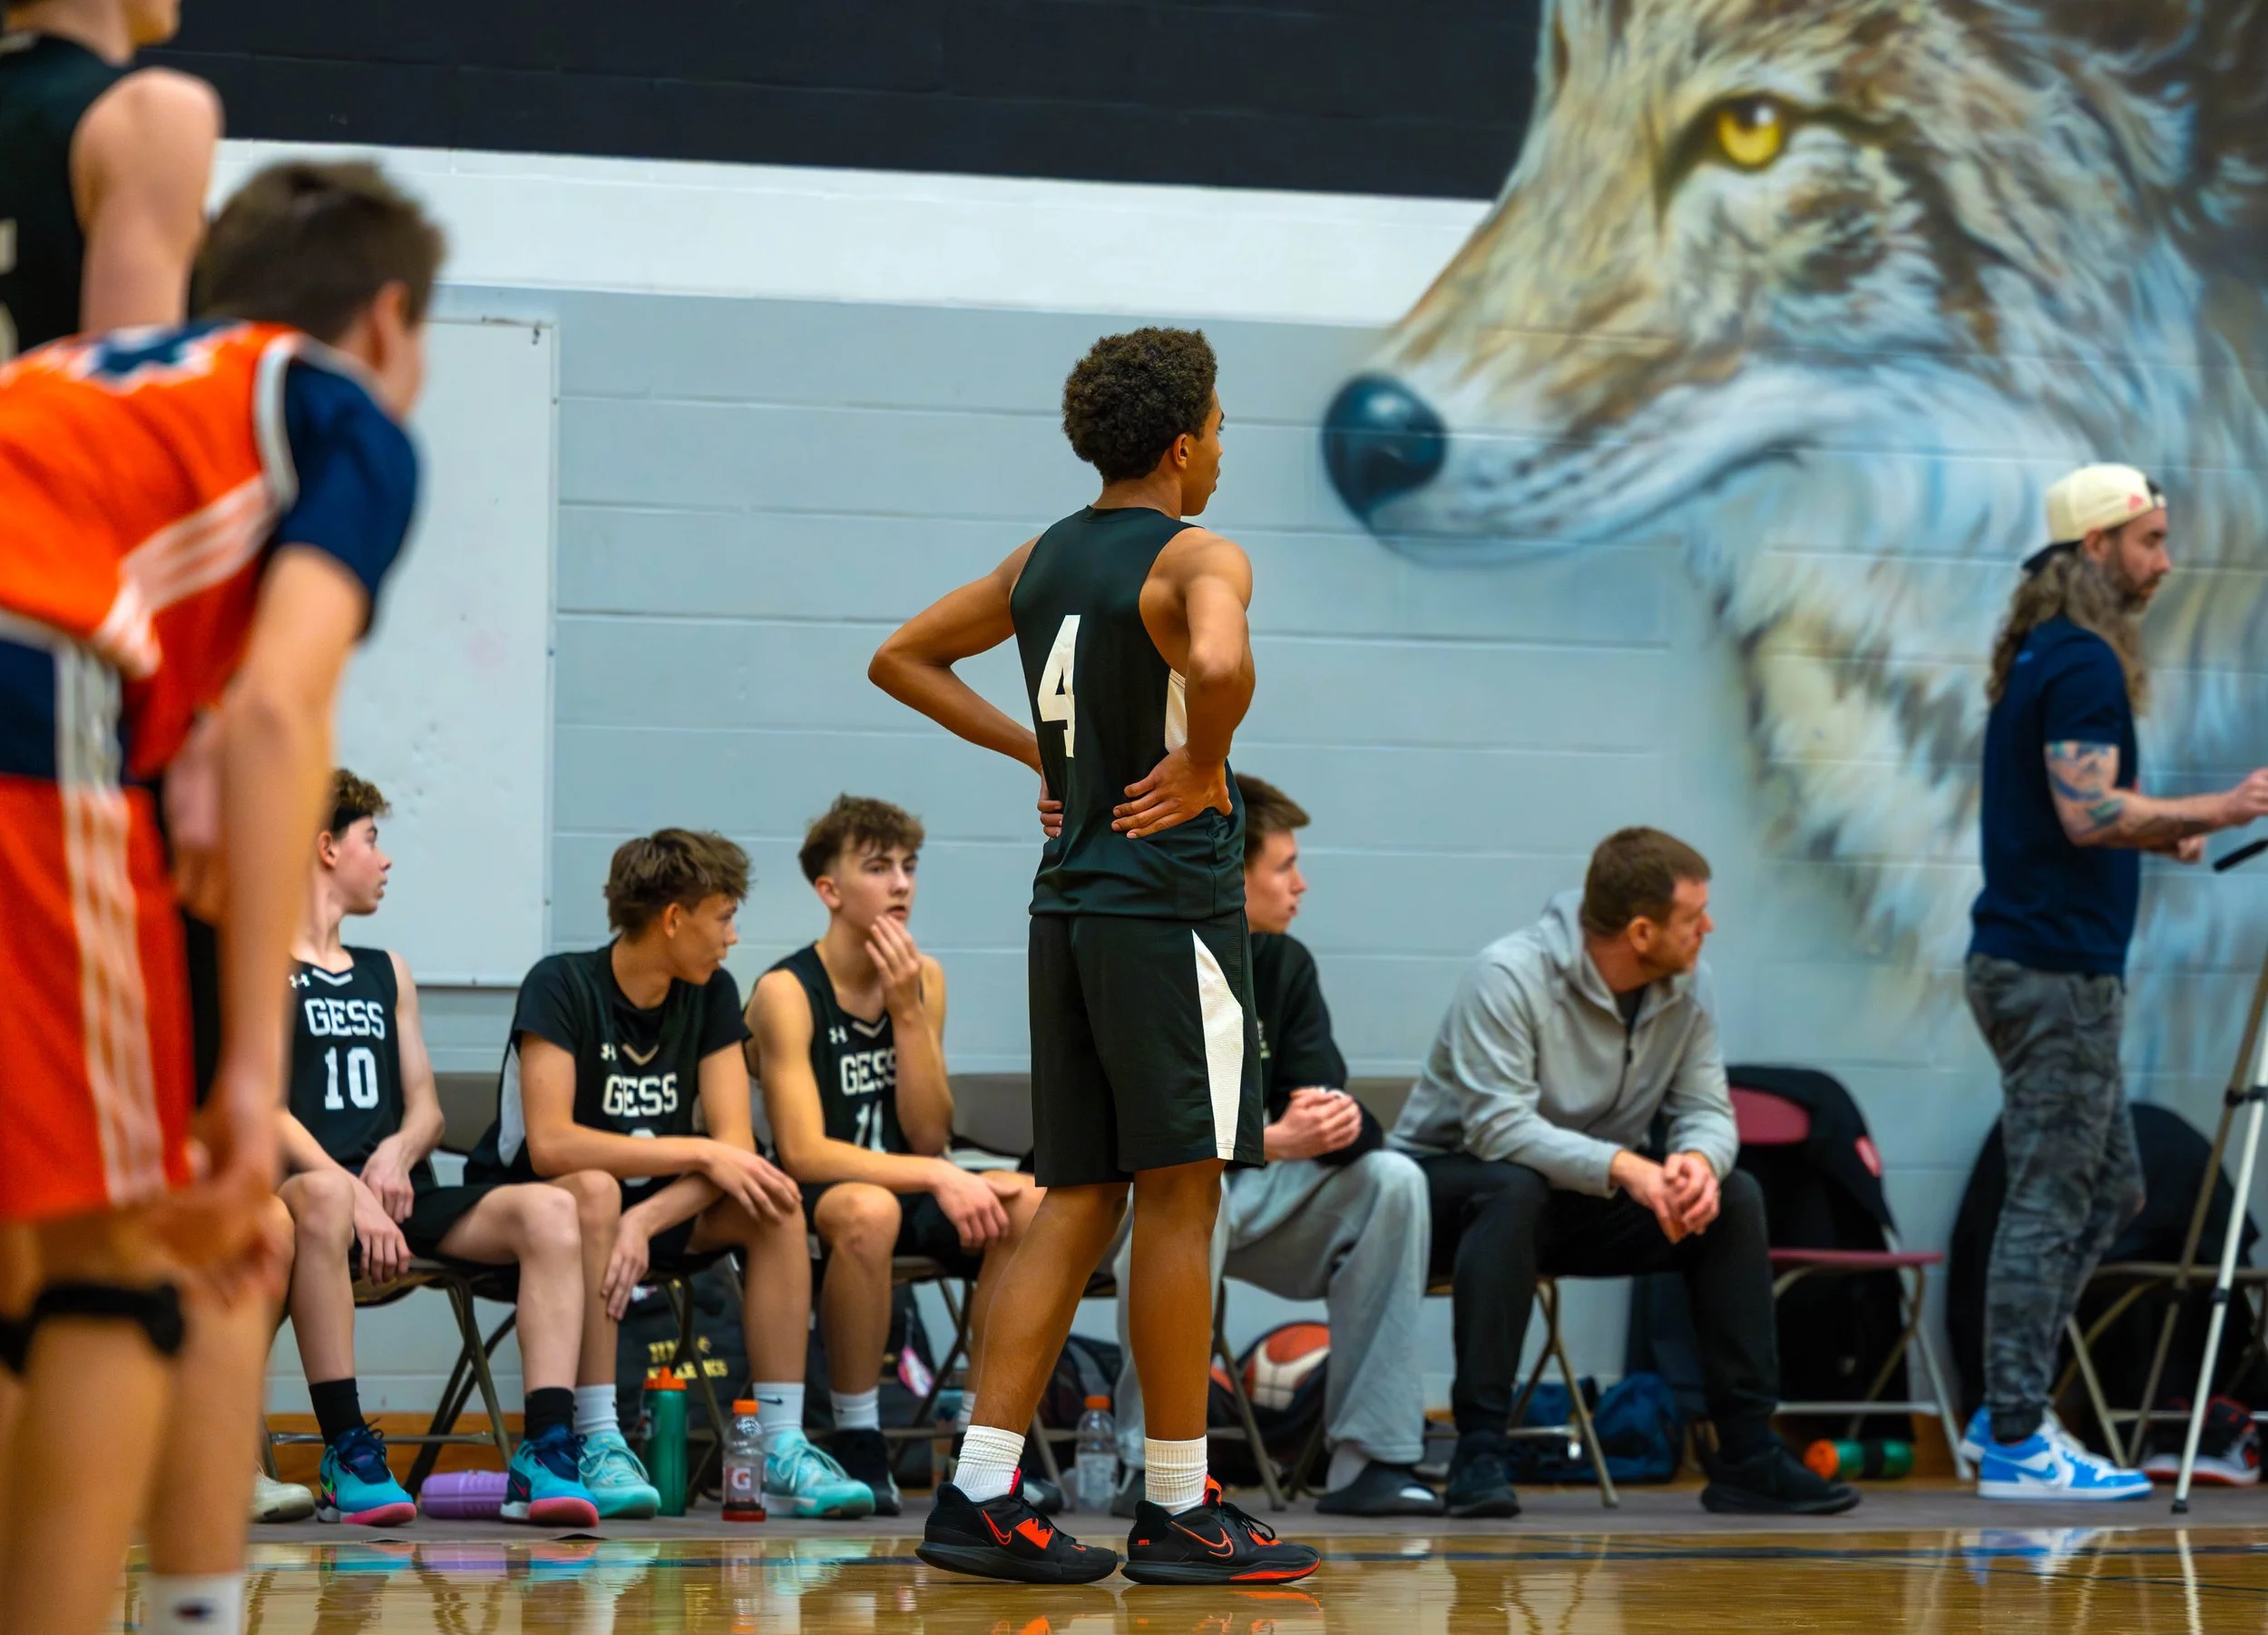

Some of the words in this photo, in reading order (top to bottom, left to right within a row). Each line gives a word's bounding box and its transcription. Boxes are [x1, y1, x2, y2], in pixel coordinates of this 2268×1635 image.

[1037, 614, 1081, 759] 4
[304, 997, 386, 1041] GESS
[324, 1045, 379, 1111] 10
[602, 1072, 679, 1117] GESS
[731, 1466, 752, 1491] G
